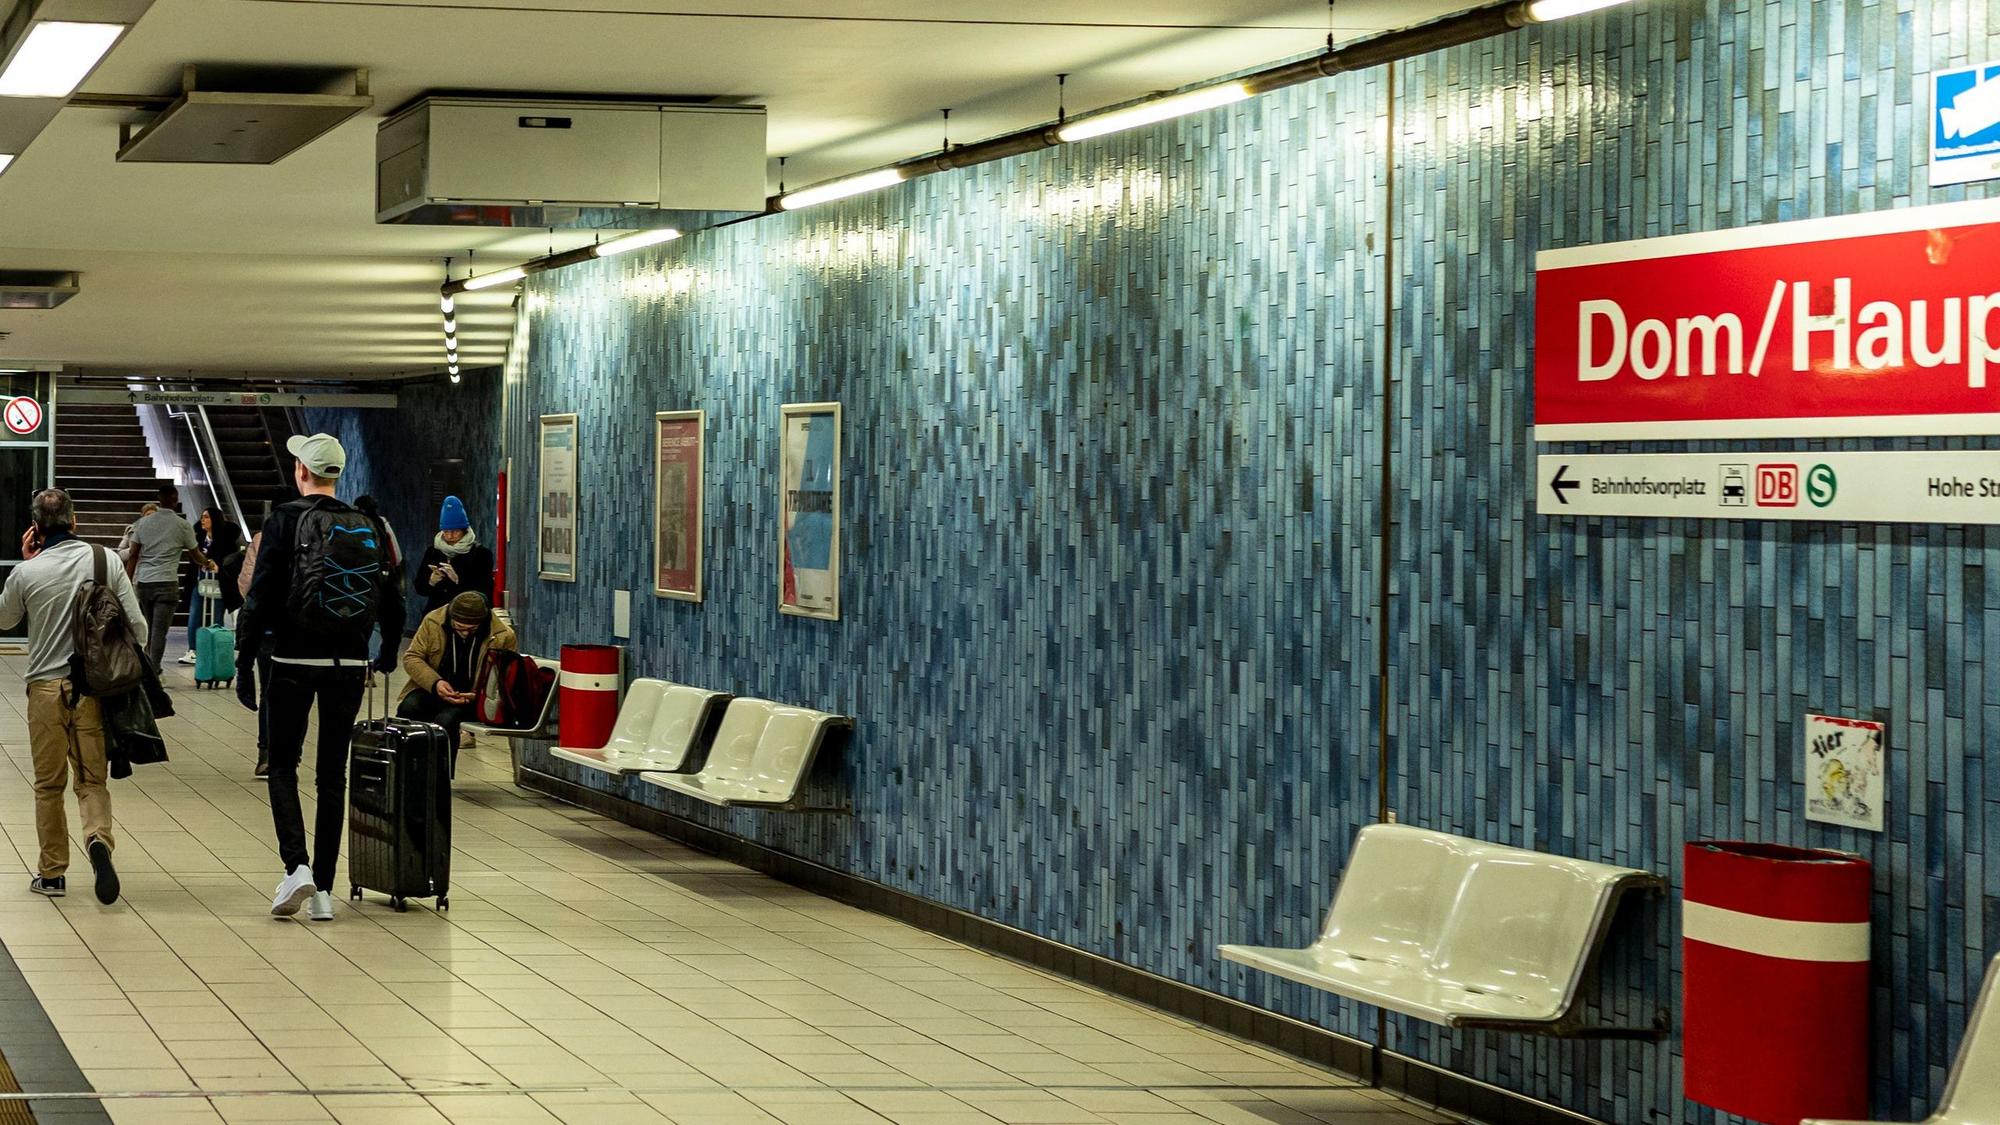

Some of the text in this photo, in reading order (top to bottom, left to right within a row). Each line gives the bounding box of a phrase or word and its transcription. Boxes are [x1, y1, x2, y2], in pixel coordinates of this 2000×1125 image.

[1578, 277, 2000, 388] Dom/Haup
[1591, 476, 1707, 498] Bahnhofsvorplatz
[1760, 470, 1794, 501] DB
[1809, 467, 1833, 505] S
[1928, 476, 1974, 497] Hohe
